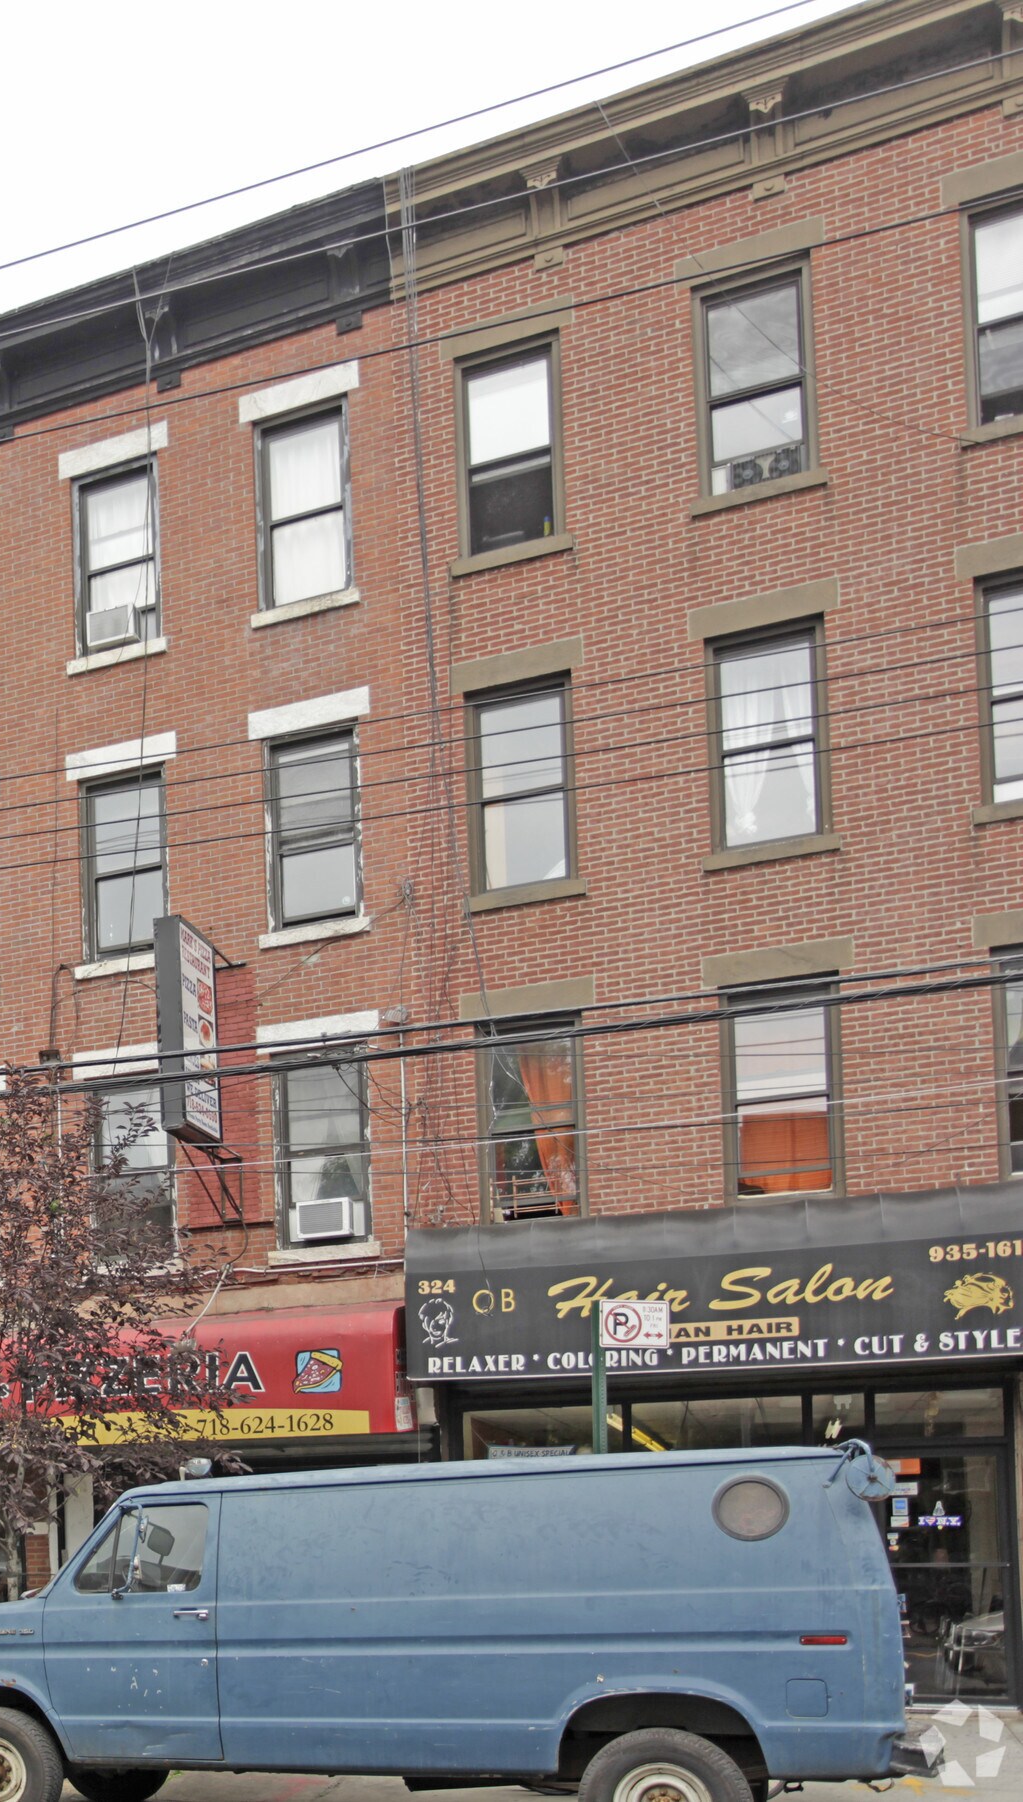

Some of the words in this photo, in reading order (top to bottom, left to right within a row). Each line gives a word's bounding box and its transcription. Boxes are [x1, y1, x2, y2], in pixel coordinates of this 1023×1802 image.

[182, 973, 197, 998] PIZZA
[183, 1011, 198, 1034] PASTA
[418, 1279, 456, 1295] 324
[708, 1263, 895, 1311] Salon
[726, 1321, 793, 1337] HAIR
[427, 1353, 525, 1374] RELAXER
[681, 1338, 829, 1365] PERMANENT
[853, 1334, 905, 1356] CUT
[913, 1332, 930, 1353] &
[939, 1328, 1023, 1351] STYLE
[23, 1350, 267, 1404] PZERIA
[196, 1413, 335, 1438] 718-624-1628
[514, 1450, 539, 1458] UNISEX
